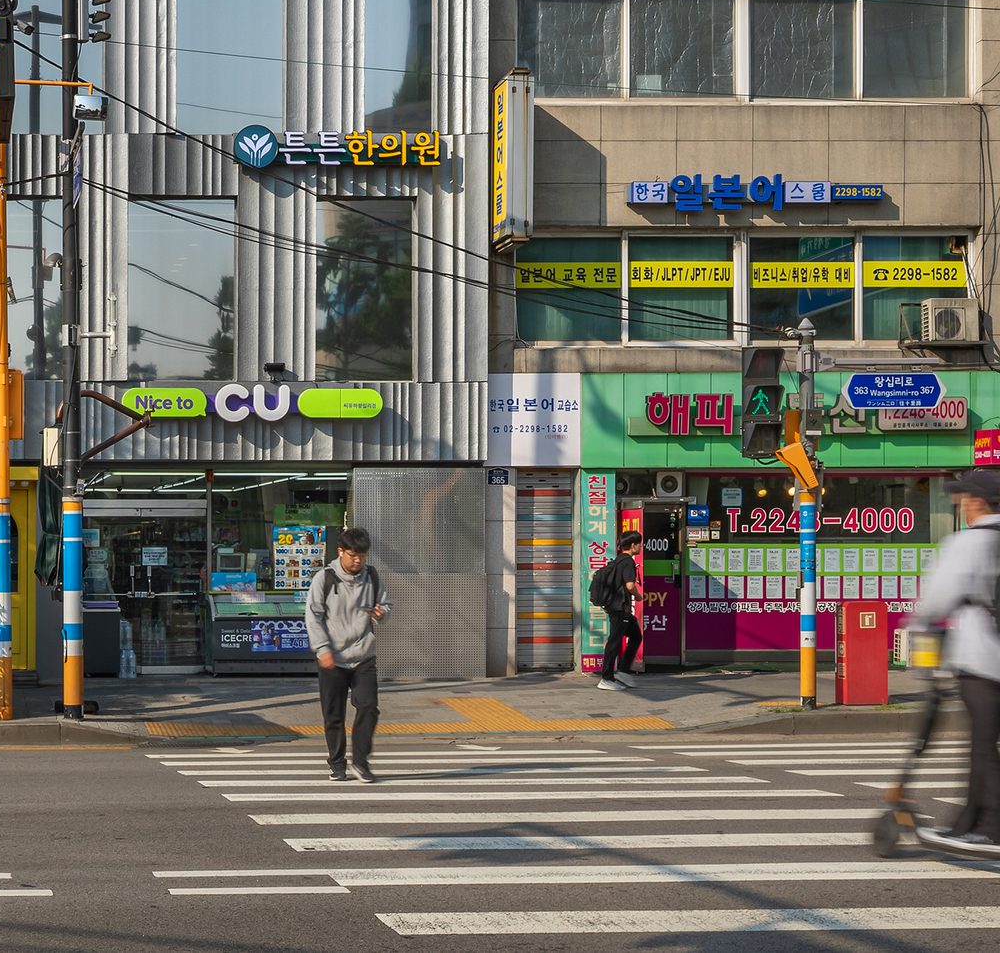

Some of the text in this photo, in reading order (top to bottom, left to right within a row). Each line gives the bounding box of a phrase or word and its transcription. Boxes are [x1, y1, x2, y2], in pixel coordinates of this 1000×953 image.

[278, 129, 441, 166] 튼튼한의원
[635, 173, 882, 212] 한국 일본어 스쿨 2298-1582
[520, 267, 617, 283] 일본어 교육 전문
[835, 267, 851, 283] 대비
[892, 267, 958, 281] 2298-1582
[875, 376, 914, 388] 왕십리로
[854, 386, 935, 398] 363 Wangsimni-ro 367
[135, 395, 194, 411] Nice to
[214, 383, 291, 423] CU
[490, 398, 578, 412] 한국 일본어 교습소
[646, 392, 734, 436] 해피
[503, 424, 568, 433] 02-2298-1582
[491, 476, 505, 485] 365
[588, 475, 607, 535] 친절하게
[278, 534, 294, 545] 20
